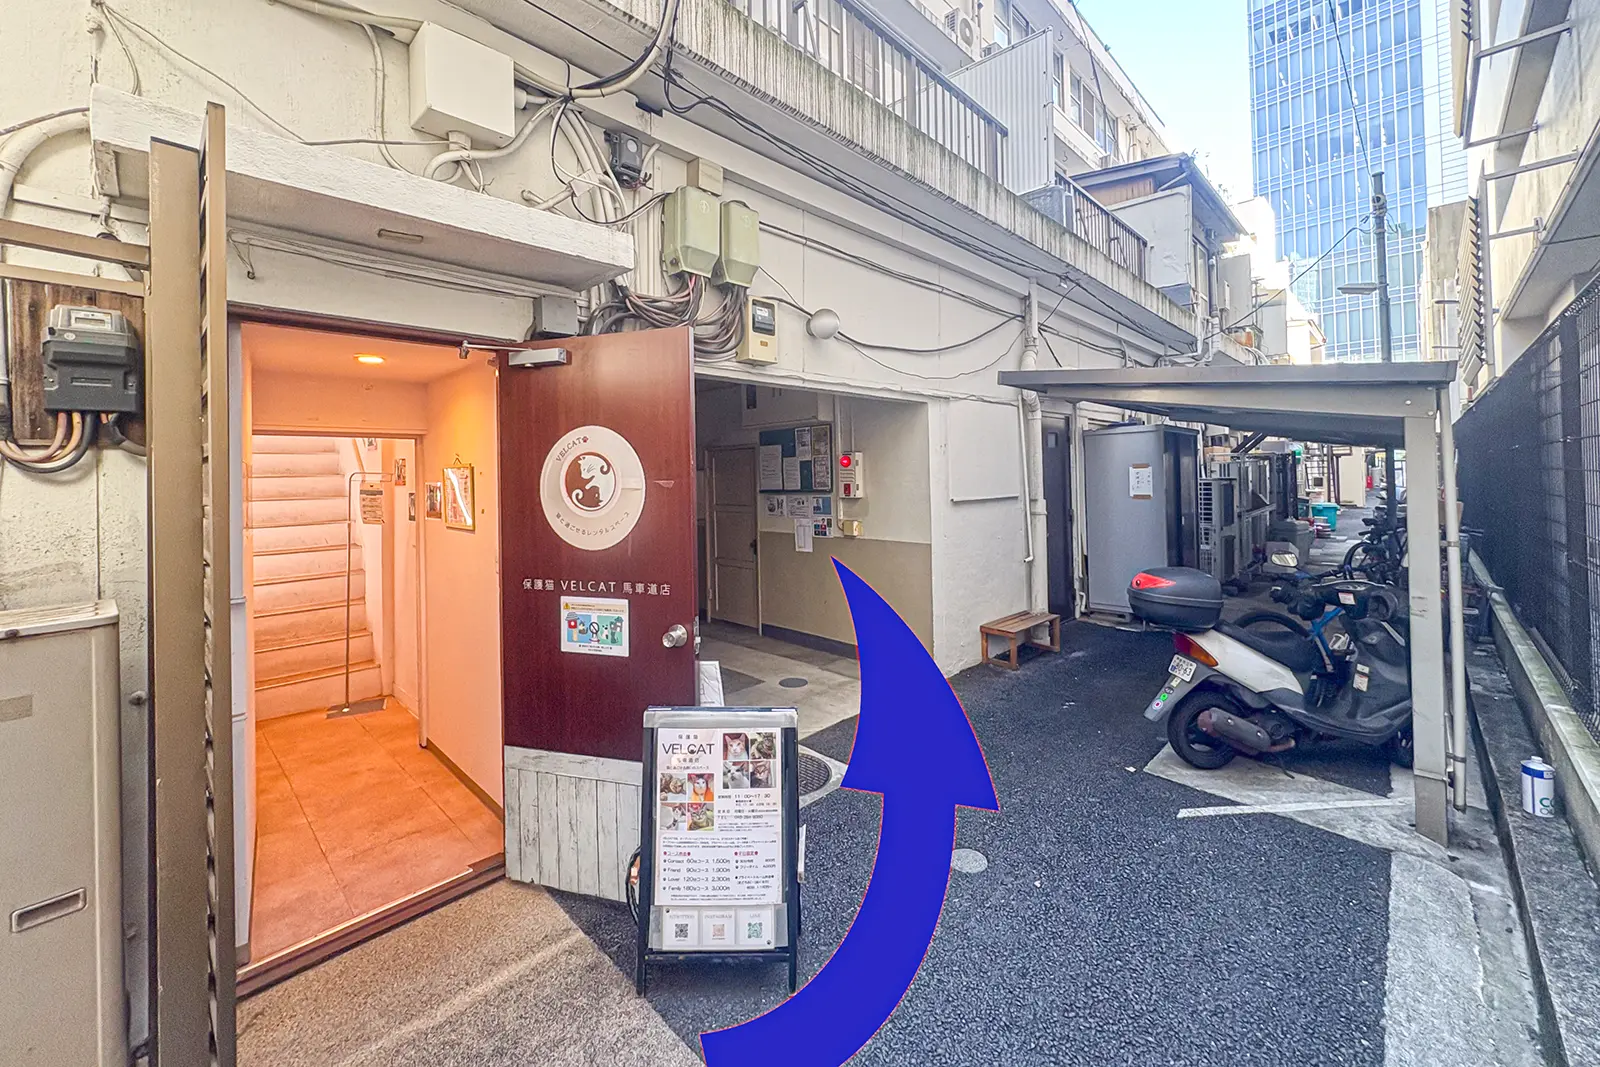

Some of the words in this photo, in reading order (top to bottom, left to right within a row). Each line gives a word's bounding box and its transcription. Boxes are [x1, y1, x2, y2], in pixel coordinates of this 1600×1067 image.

[555, 437, 581, 462] VELCAT
[523, 578, 554, 590] 保護猫
[561, 580, 616, 592] VELCAT
[623, 582, 671, 595] 馬車道店
[662, 743, 715, 754] VELCAT
